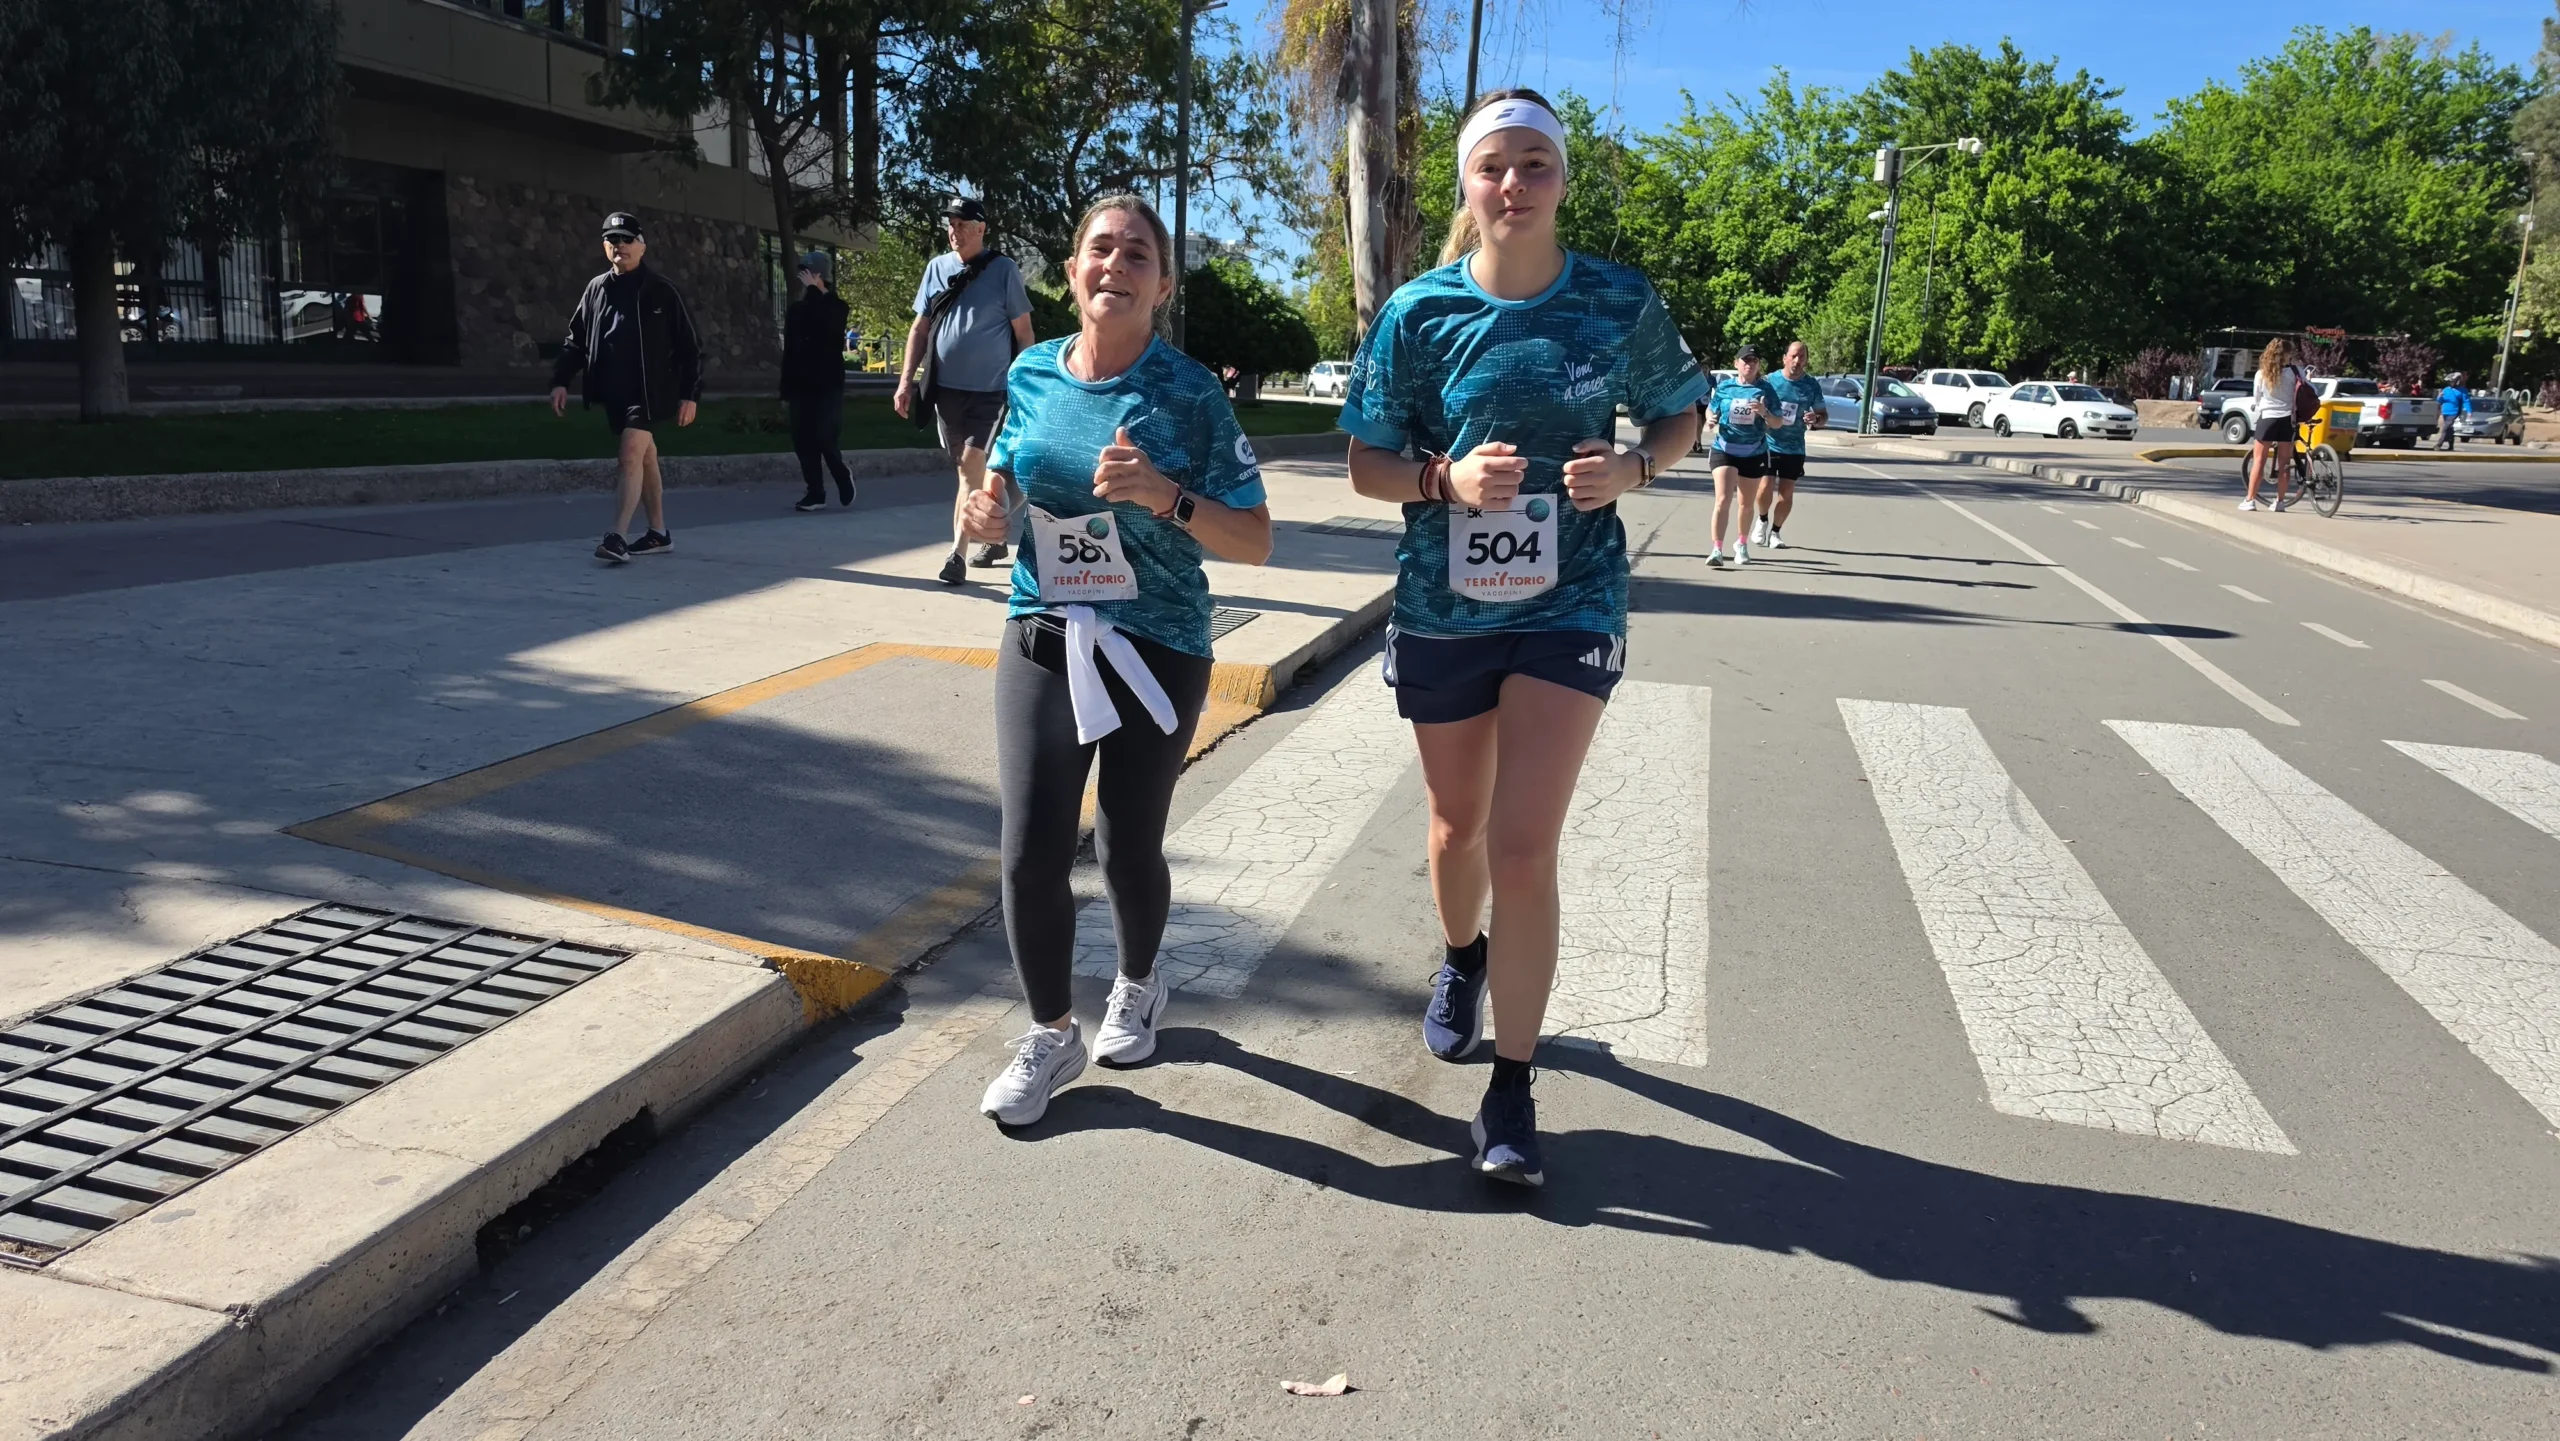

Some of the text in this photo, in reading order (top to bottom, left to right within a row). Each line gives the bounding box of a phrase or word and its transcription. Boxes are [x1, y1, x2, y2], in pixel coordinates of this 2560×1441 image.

[1239, 464, 1258, 480] GATO
[1058, 534, 1111, 564] 581
[1465, 531, 1541, 565] 504
[1053, 570, 1126, 585] TERRITORIO
[1464, 571, 1546, 587] TERRITORIO
